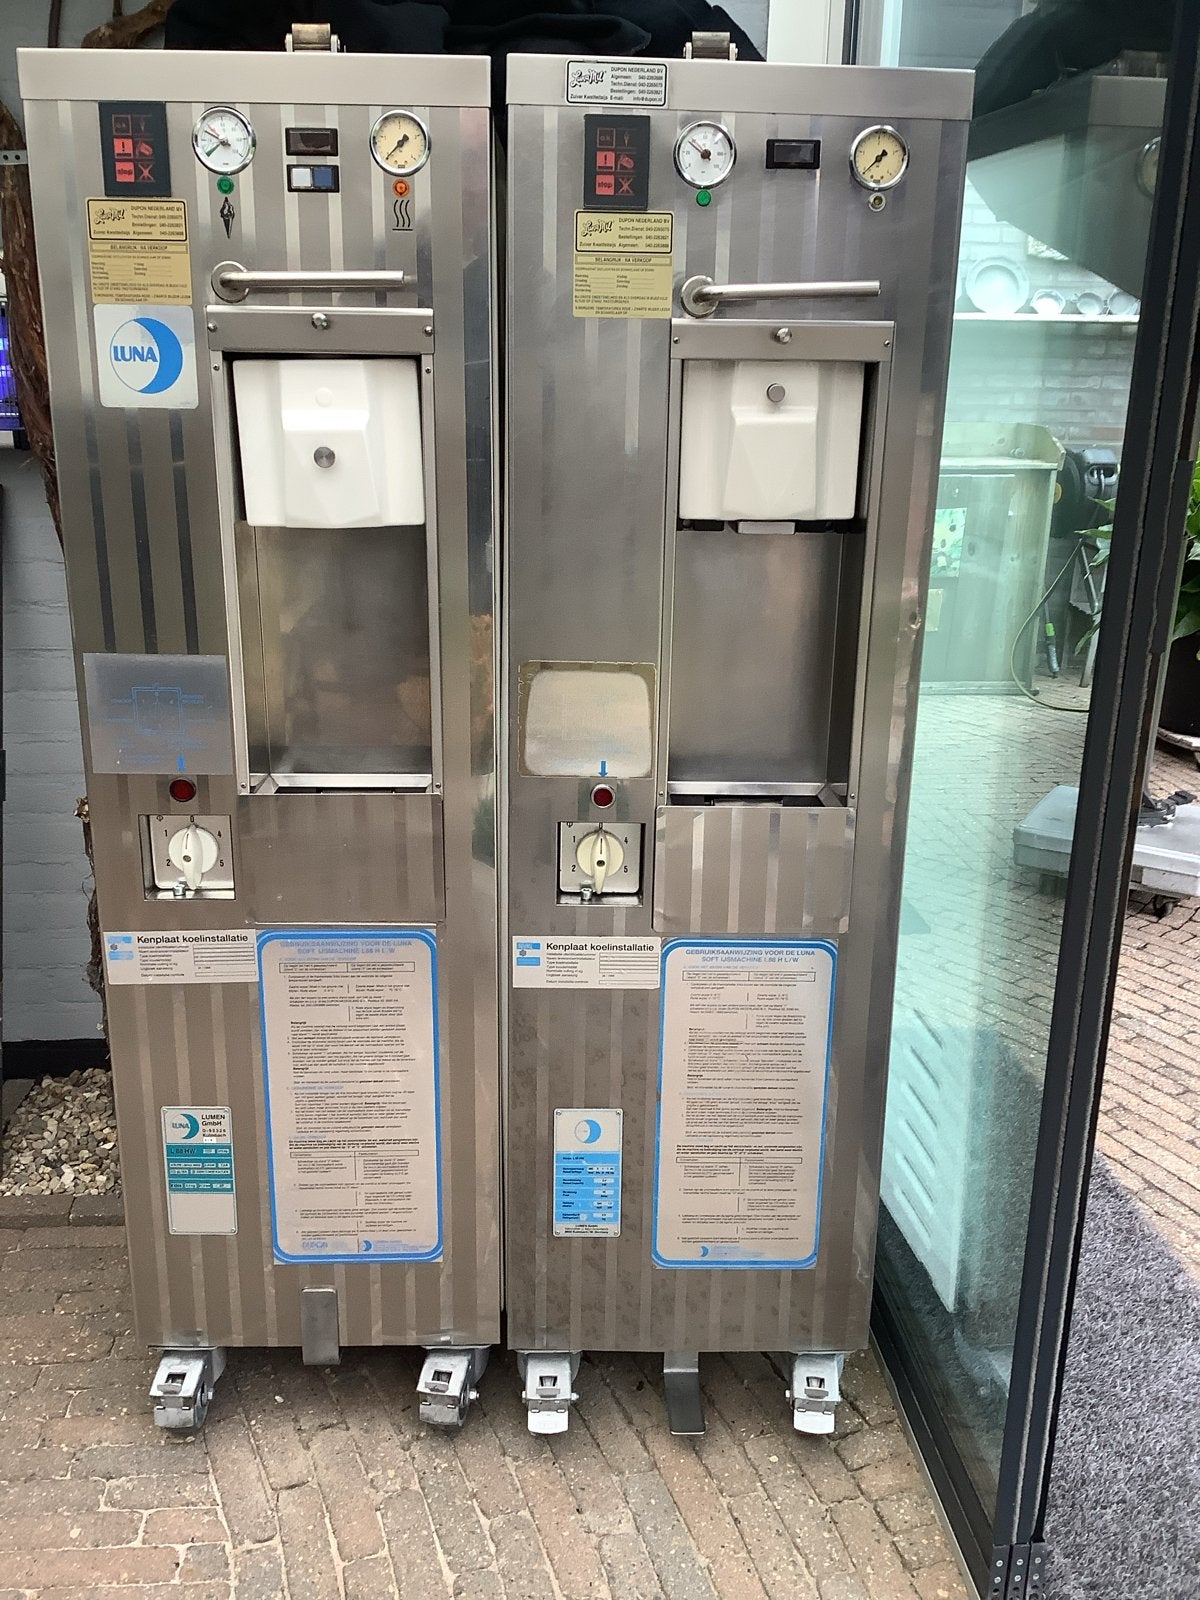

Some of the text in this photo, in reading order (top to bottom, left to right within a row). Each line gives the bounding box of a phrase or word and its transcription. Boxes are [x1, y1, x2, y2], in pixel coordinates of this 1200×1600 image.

[113, 346, 158, 362] LUNA
[137, 934, 248, 944] Kenplaat koelinstallatie
[546, 942, 655, 952] Kenplaat koelinstallatie
